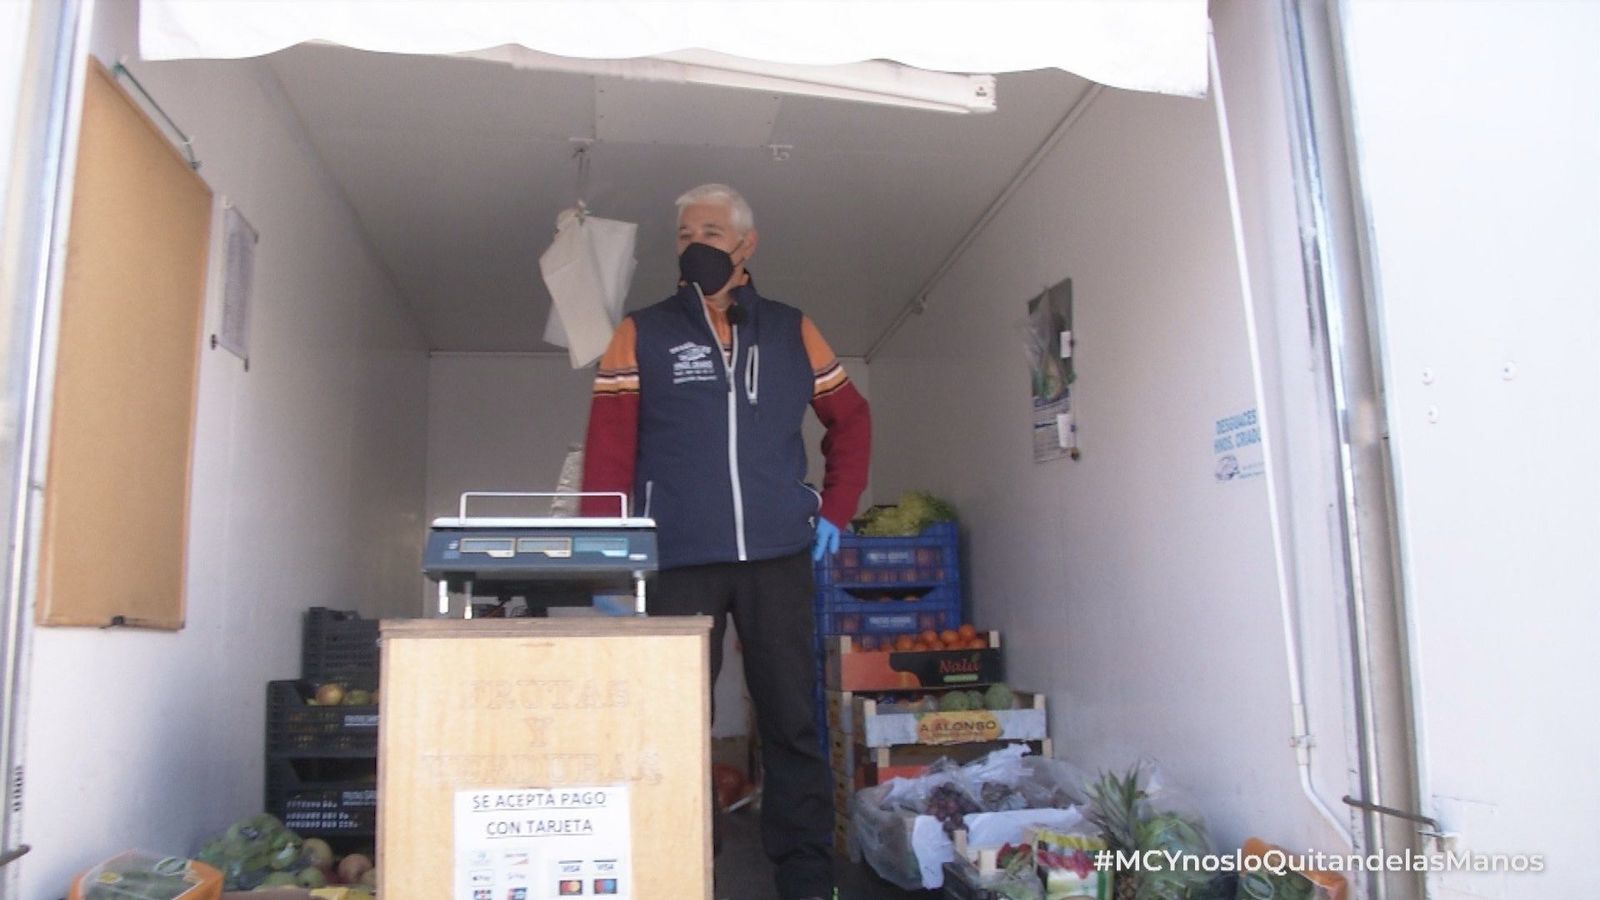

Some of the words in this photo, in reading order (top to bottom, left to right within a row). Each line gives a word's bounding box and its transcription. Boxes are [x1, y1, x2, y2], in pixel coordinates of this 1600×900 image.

[460, 678, 631, 711] FRUTAS
[523, 715, 553, 748] Y
[472, 794, 490, 810] SE
[495, 792, 556, 809] ACEPTA
[560, 791, 608, 806] PAGO
[486, 821, 521, 836] CON
[526, 819, 594, 834] TARJETA
